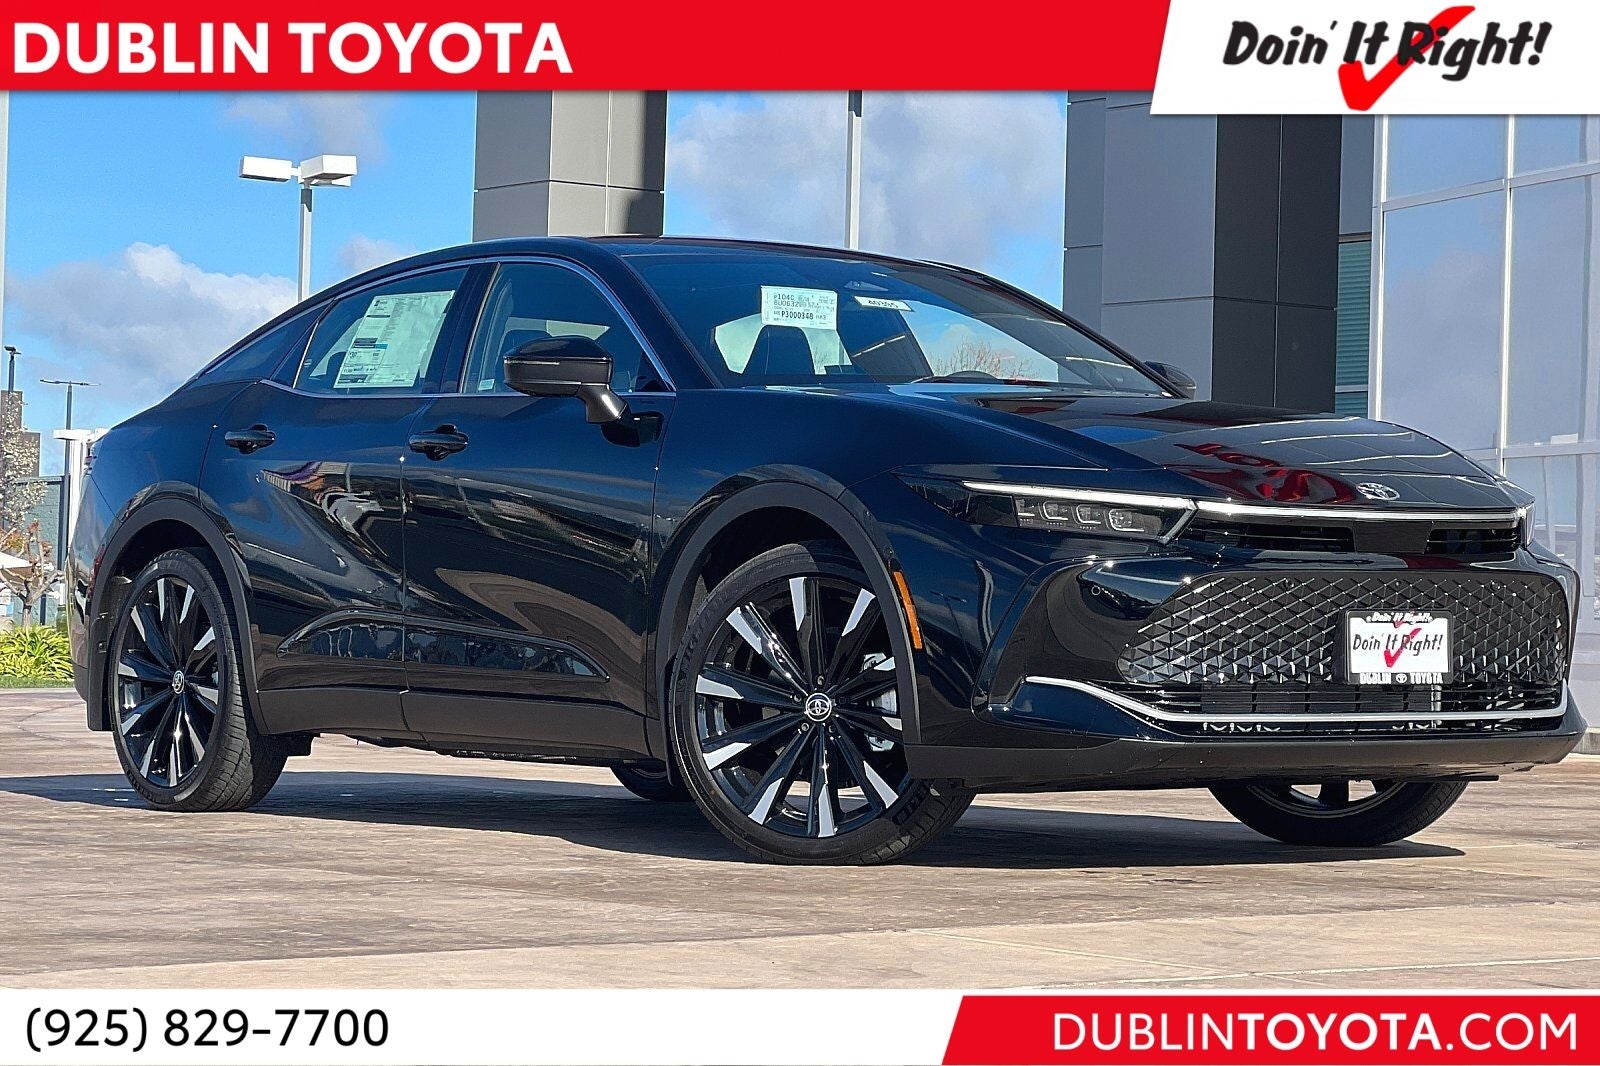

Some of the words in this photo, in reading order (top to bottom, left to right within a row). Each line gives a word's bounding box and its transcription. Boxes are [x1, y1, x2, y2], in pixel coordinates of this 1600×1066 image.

[1385, 633, 1399, 651] It
[1400, 633, 1444, 657] Right!
[1359, 672, 1392, 685] DUBLIN
[1409, 672, 1444, 685] TOYOTA
